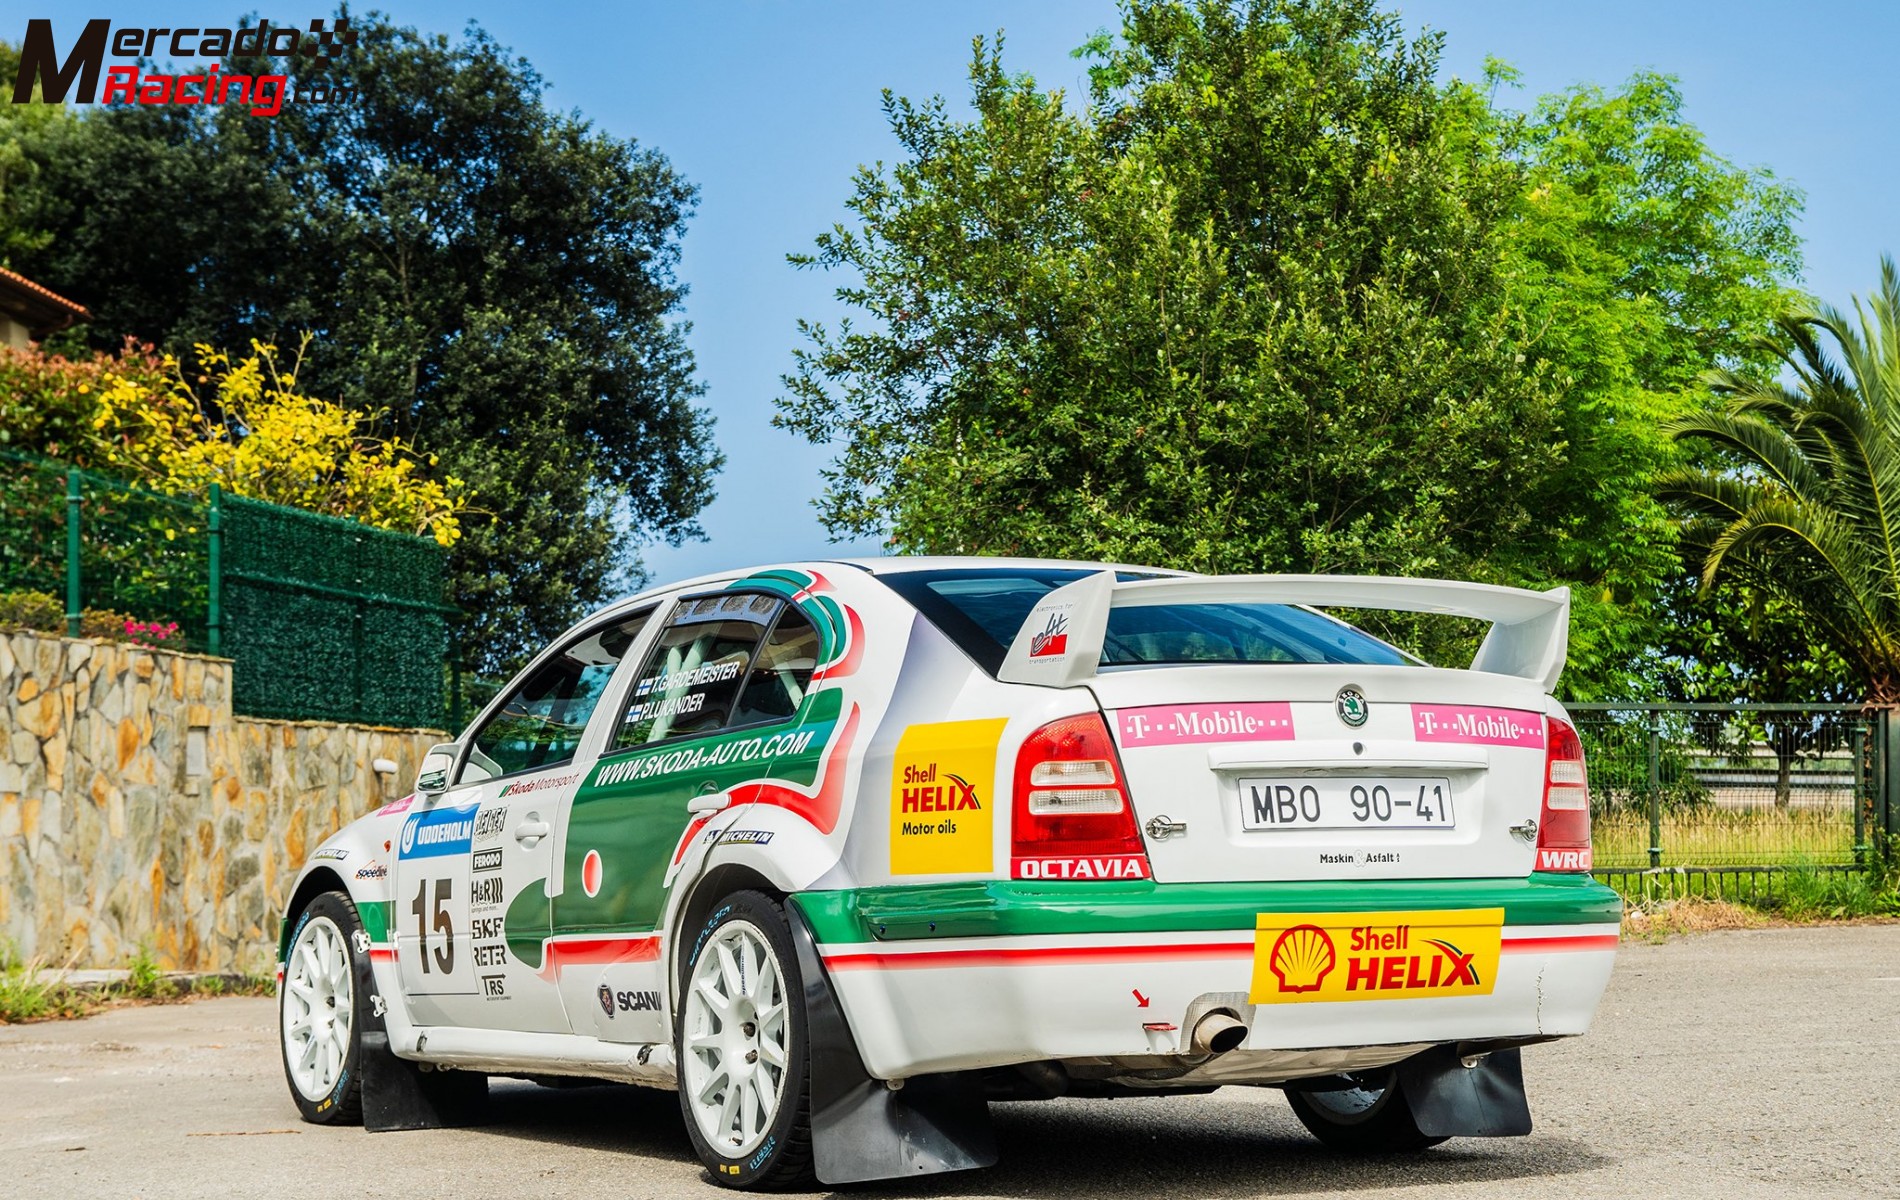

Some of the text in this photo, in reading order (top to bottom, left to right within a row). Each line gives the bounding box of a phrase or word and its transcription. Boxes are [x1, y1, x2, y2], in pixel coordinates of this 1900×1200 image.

[651, 661, 740, 693] T.GARDEMEISTER
[640, 693, 706, 719] P.LUKANDER
[594, 731, 815, 787] WWW.SKODA-AUTO.COM
[903, 763, 937, 784] Shell
[902, 774, 981, 813] HELIX
[1350, 785, 1446, 822] 90-41
[417, 820, 473, 845] UDDEHOLM
[719, 831, 773, 842] MICHELIN
[902, 818, 957, 835] Motor oils
[474, 853, 500, 868] FERODO
[1020, 859, 1143, 878] OCTAVIA
[1320, 854, 1354, 863] Maskin
[1366, 853, 1394, 863] Asfalt
[1541, 851, 1588, 868] WRC
[412, 878, 454, 975] 15
[472, 917, 503, 940] SKF
[1350, 925, 1409, 951] Shell
[1346, 939, 1480, 991] HELIX
[617, 991, 662, 1011] SCANI
